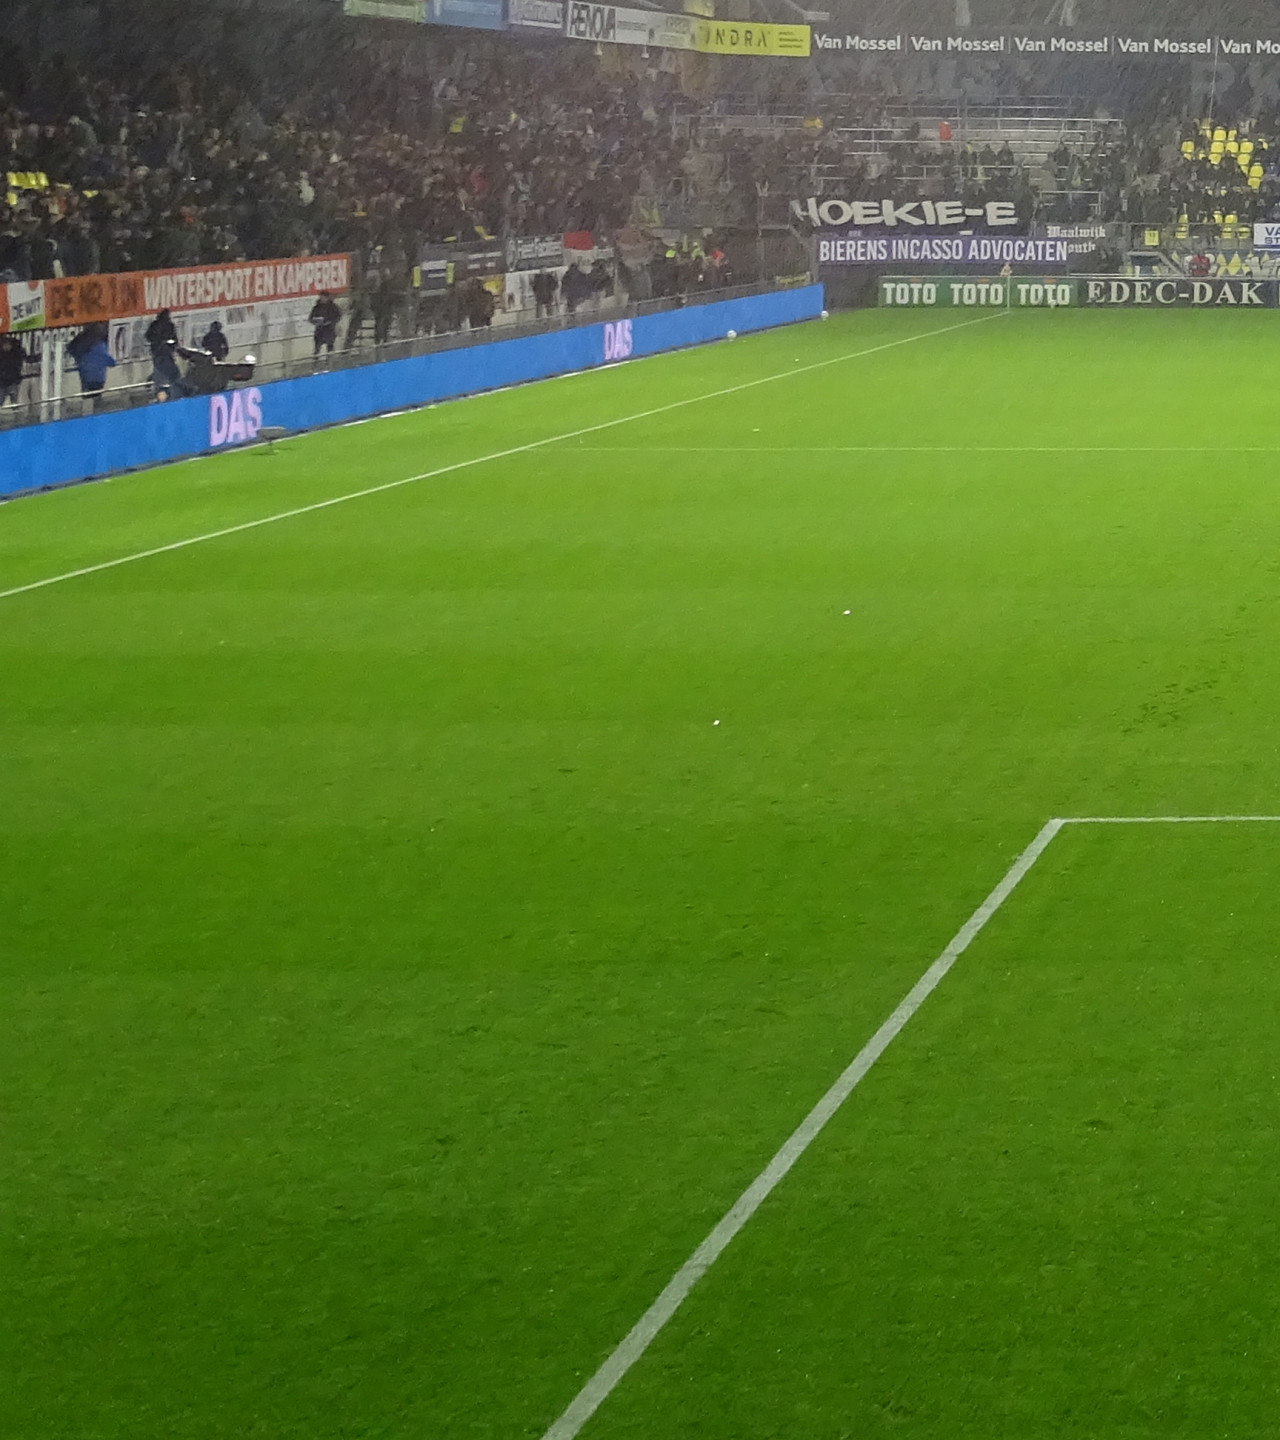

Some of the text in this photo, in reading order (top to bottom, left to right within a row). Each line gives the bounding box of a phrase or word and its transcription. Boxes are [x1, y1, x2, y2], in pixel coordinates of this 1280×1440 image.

[815, 34, 841, 49] Van
[846, 35, 901, 50] Mossel
[911, 36, 1004, 51] Van Mossel
[1014, 37, 1108, 52] Van Mossel
[1118, 38, 1211, 53] Van Mossel
[1221, 39, 1251, 54] Van
[1047, 225, 1106, 241] Waalwijk
[820, 239, 1068, 261] BIERENS INCASSO ADVOCATEN
[144, 268, 252, 310] WINTERSPORT
[255, 266, 275, 296] EN
[277, 258, 348, 295] KAMPEREN
[883, 283, 937, 305] TOTO
[951, 284, 1005, 305] TOTO
[1018, 284, 1071, 305] TOTO
[1086, 281, 1264, 305] EDEC-DAK
[604, 319, 633, 360] DAS
[209, 388, 263, 446] DAS
